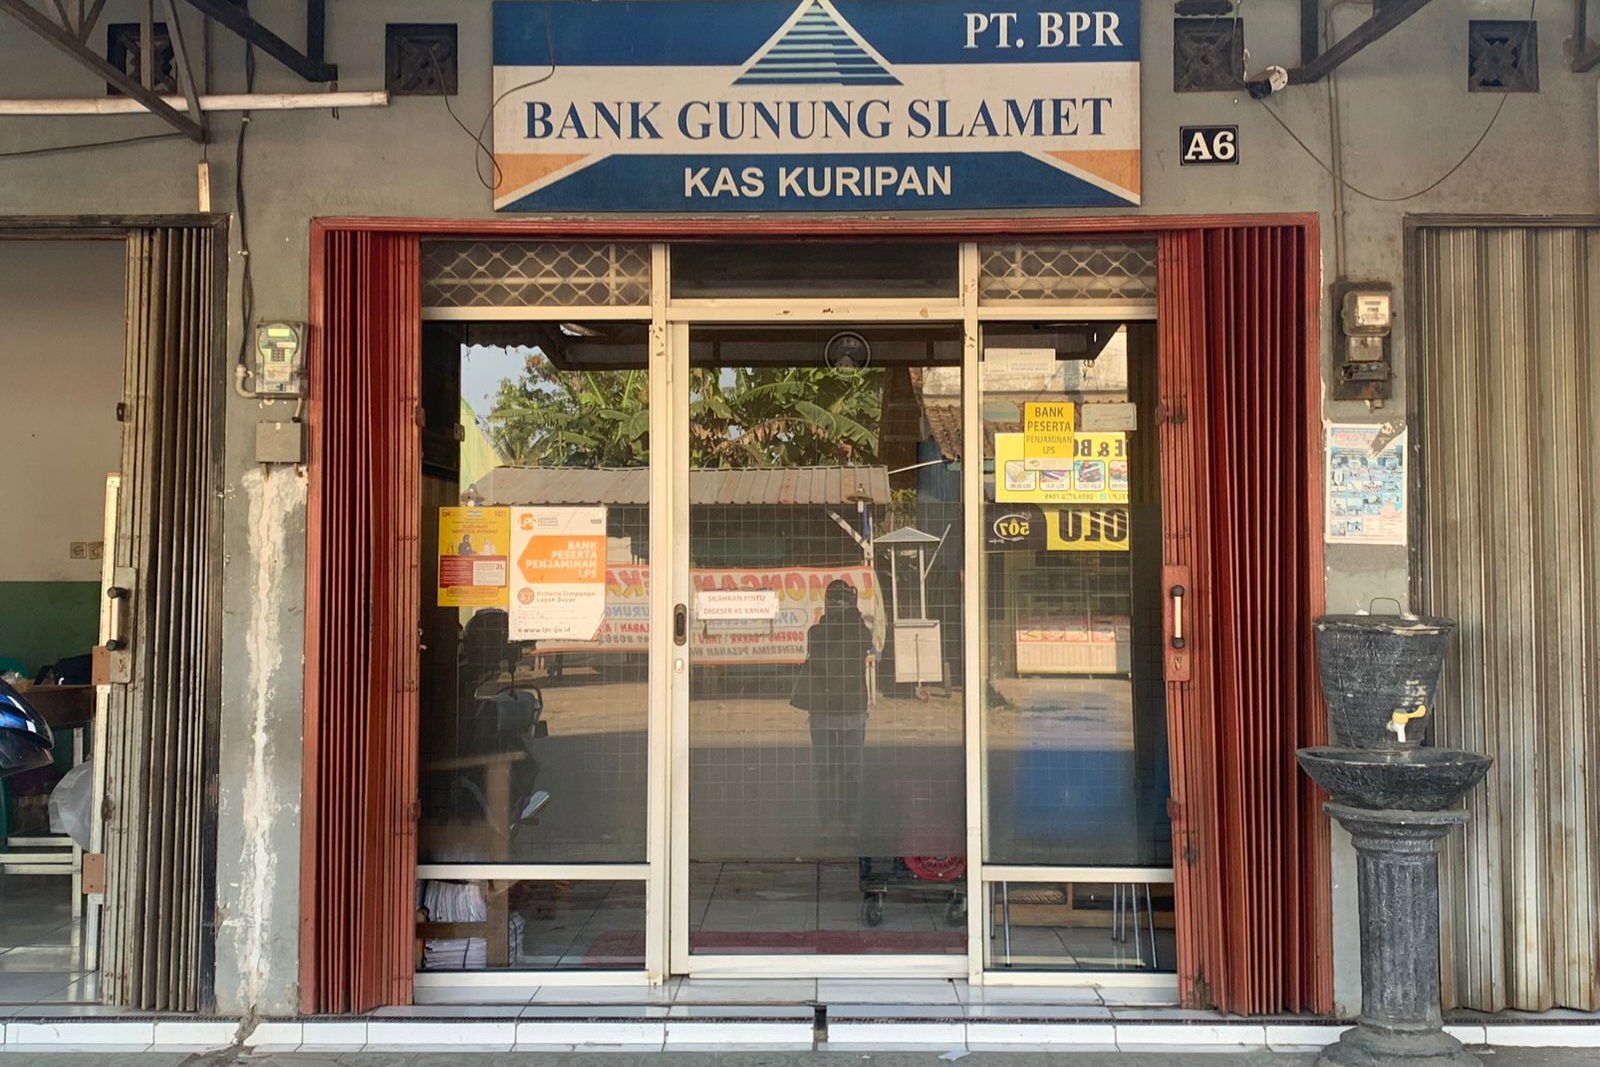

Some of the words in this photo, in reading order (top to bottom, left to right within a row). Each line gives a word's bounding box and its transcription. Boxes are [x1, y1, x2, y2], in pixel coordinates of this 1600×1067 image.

[964, 12, 1024, 49] PT.
[1037, 11, 1123, 48] BPR
[523, 100, 662, 140] BANK
[677, 99, 891, 141] GUNUNG
[907, 97, 1112, 138] SLAMET
[1184, 131, 1237, 161] A6
[683, 167, 765, 198] KAS
[778, 165, 952, 197] KURIPAN
[1034, 406, 1064, 418] BANK
[1027, 421, 1072, 433] PESERTA
[1025, 434, 1072, 444] PENJAMINAN
[1042, 446, 1056, 455] LPS
[567, 541, 598, 550] BANK
[551, 550, 598, 559] PESERTA
[525, 559, 598, 570] PENJAMINAN
[578, 569, 598, 579] LPS
[707, 594, 743, 602] SILAHKAN
[744, 594, 766, 602] PINTU
